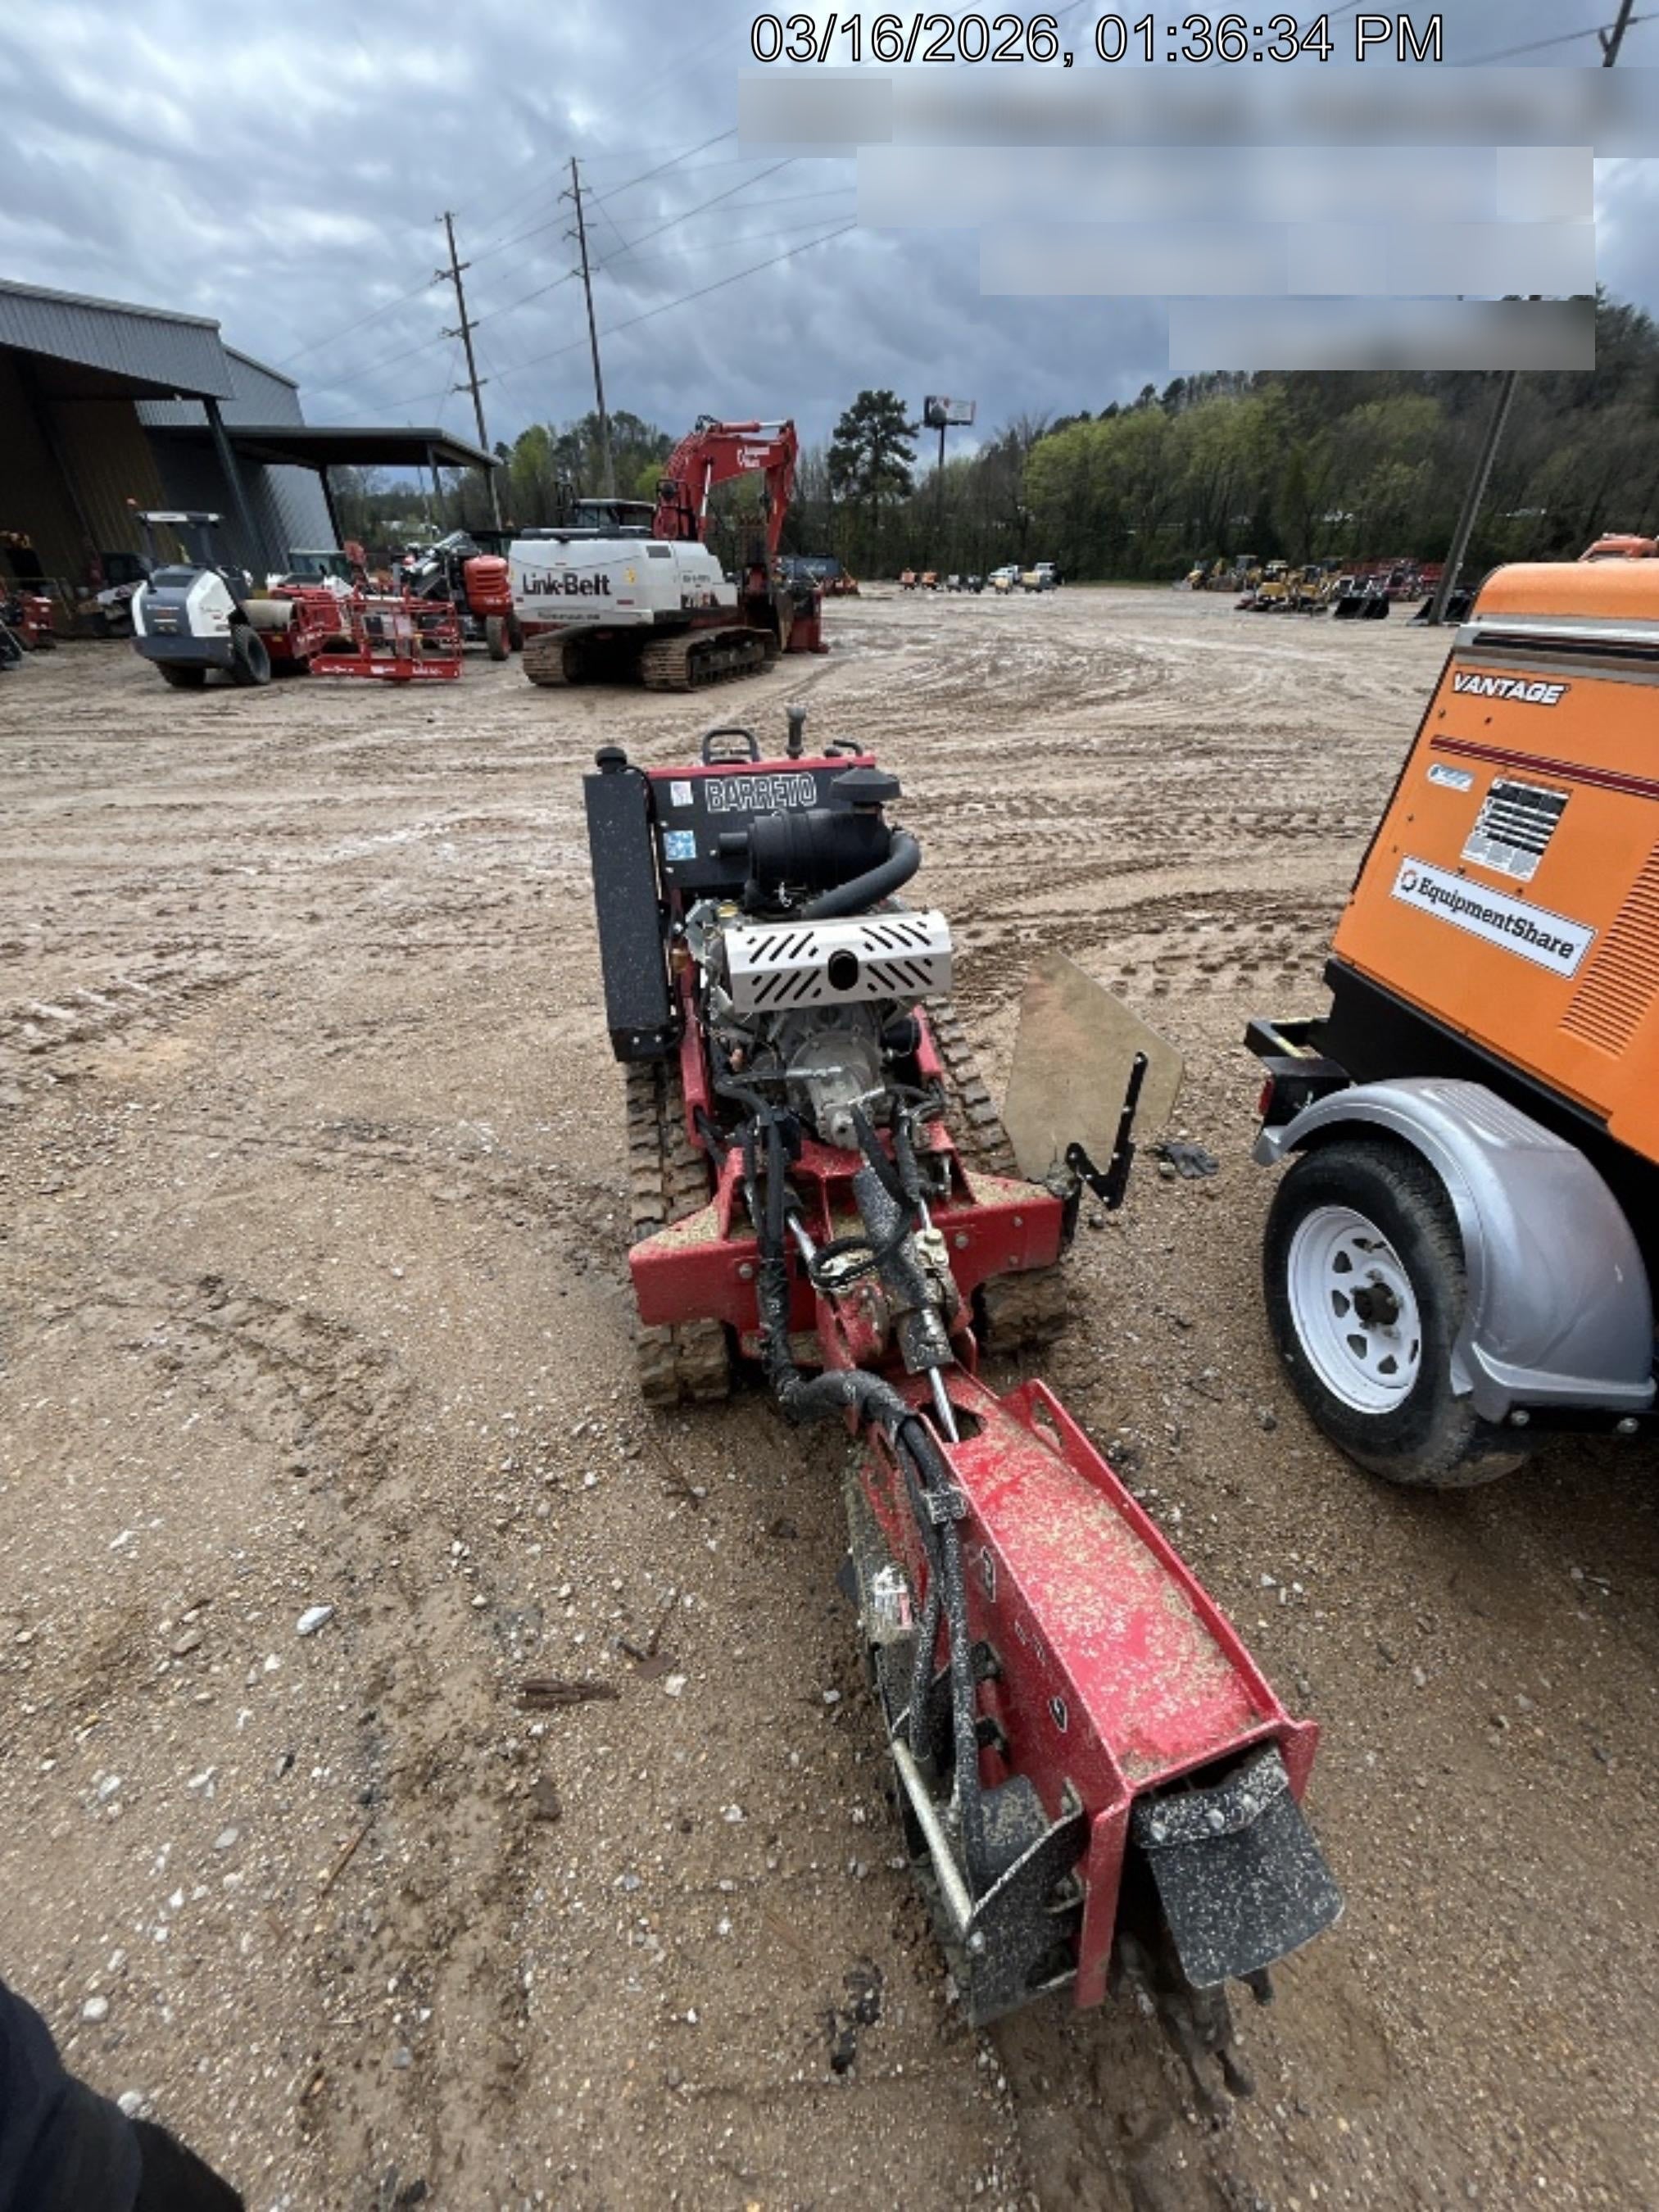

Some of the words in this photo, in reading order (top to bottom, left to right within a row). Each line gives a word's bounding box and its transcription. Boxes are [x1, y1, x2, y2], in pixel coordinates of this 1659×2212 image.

[523, 572, 611, 596] Link-Belt
[1453, 672, 1568, 705] VANTAGE
[705, 772, 818, 813] BARRETO
[1418, 877, 1575, 959] EquipmentShare
